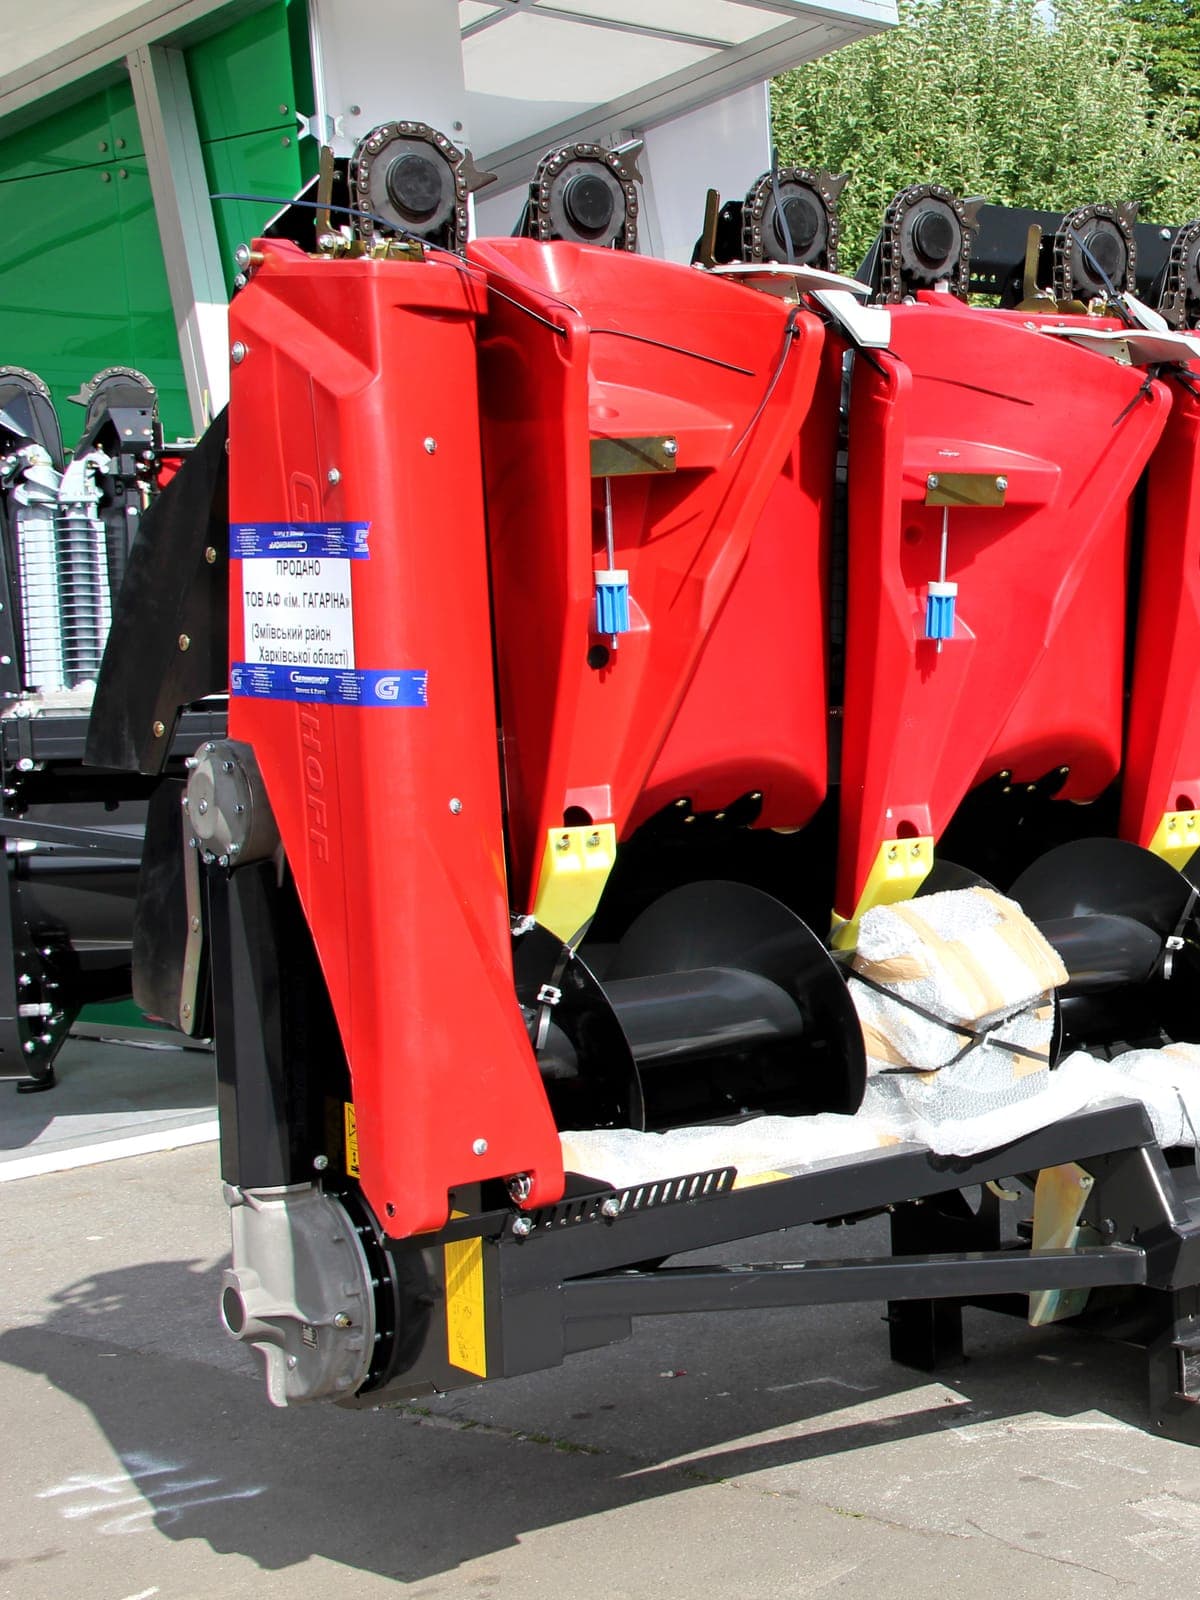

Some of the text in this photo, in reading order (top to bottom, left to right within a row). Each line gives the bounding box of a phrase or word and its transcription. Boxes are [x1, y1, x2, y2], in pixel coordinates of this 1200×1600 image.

[276, 560, 321, 578] ПРОДАНО
[245, 592, 263, 607] ТОВ
[266, 592, 281, 607] АФ
[303, 592, 350, 609] ГАГАРІНА»
[251, 623, 331, 646] (Зміївський район
[259, 646, 349, 669] Харківської області)
